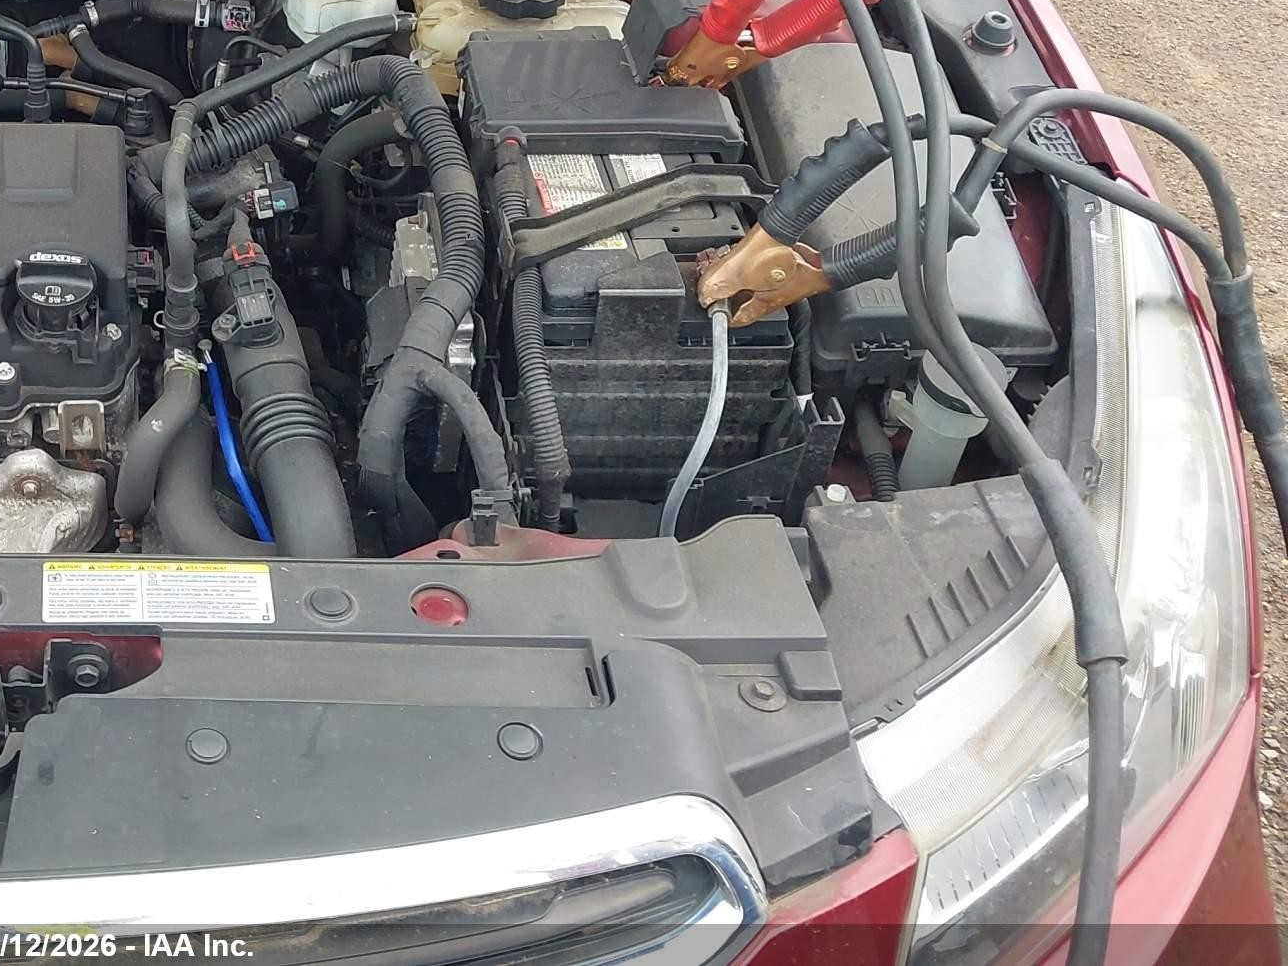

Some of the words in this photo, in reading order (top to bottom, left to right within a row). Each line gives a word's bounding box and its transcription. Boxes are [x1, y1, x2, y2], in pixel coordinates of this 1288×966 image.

[29, 251, 84, 264] dexos
[32, 292, 47, 303] SAE
[48, 294, 75, 304] 5W-30
